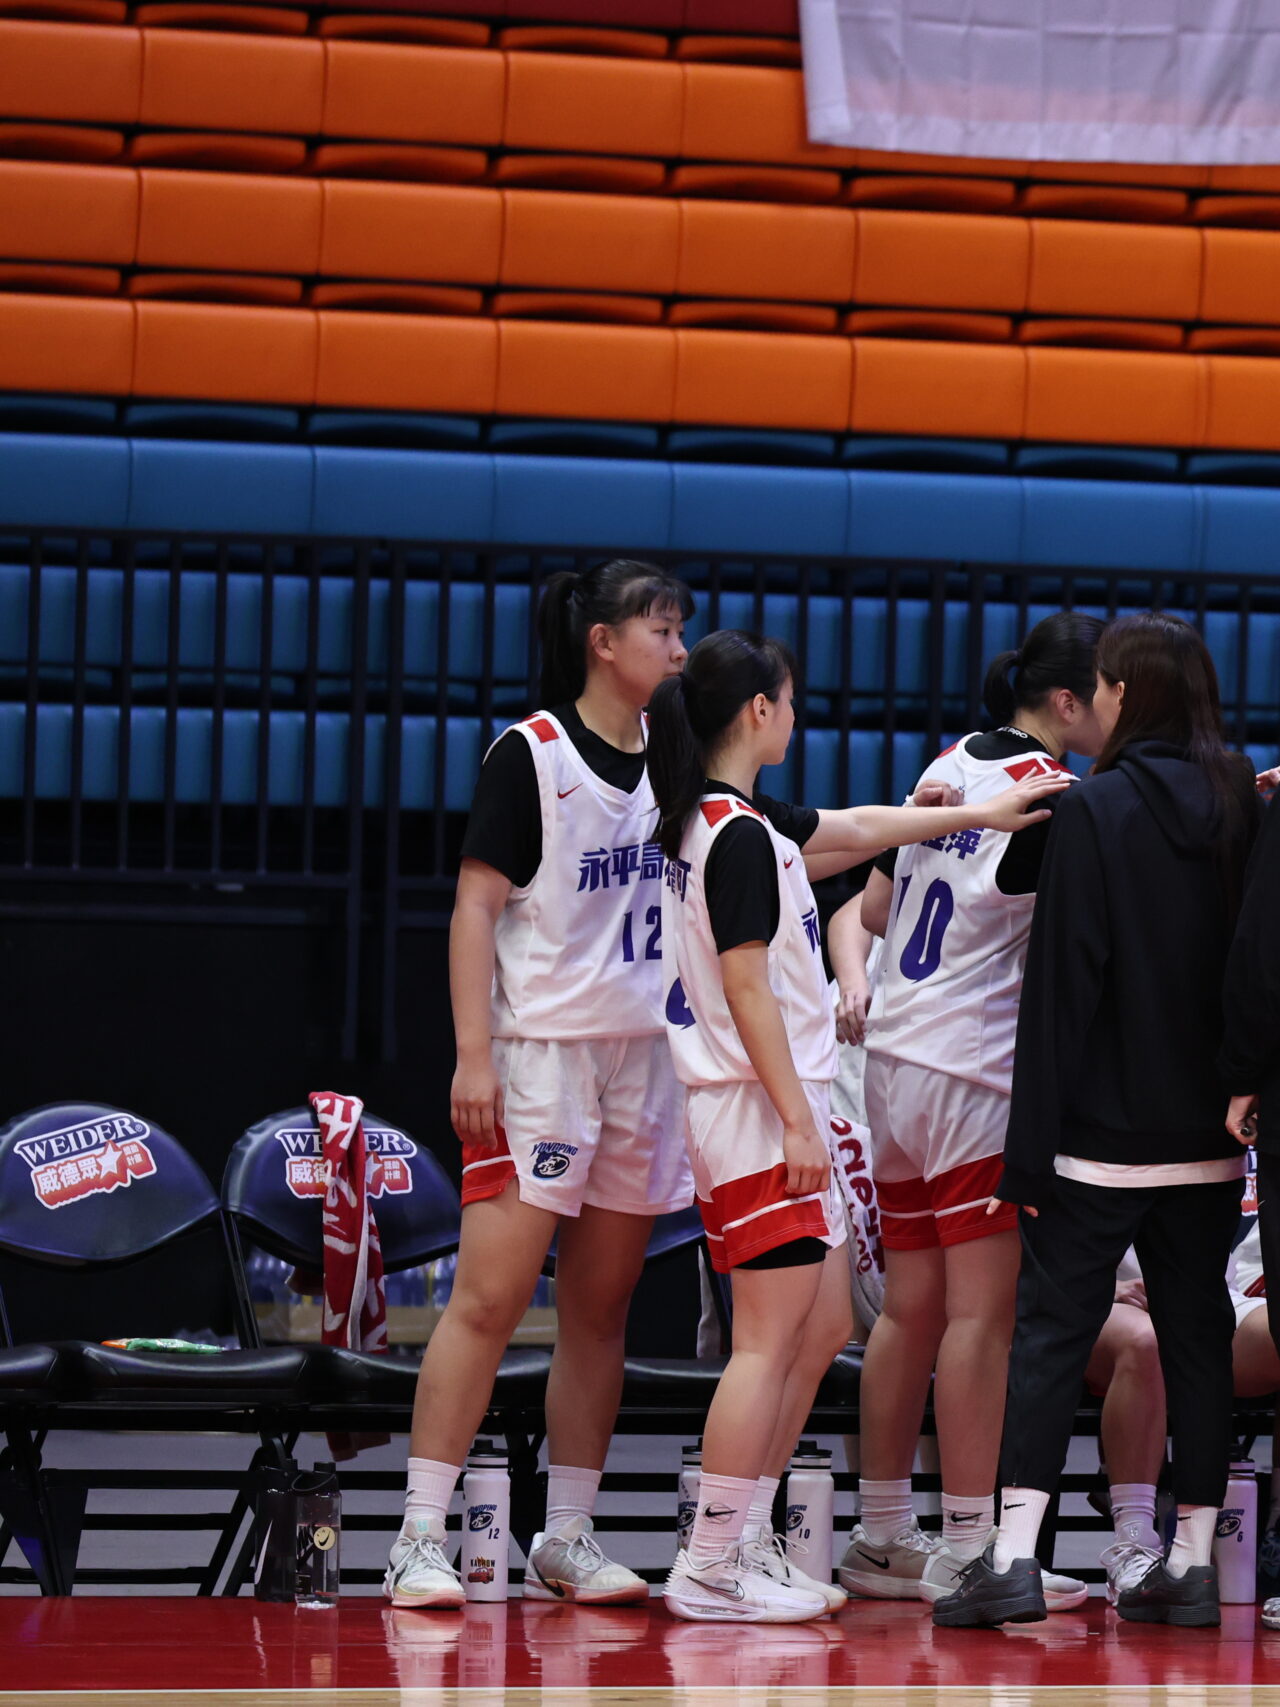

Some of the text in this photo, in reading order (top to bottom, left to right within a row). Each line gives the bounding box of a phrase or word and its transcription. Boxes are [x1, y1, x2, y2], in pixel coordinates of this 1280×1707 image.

[622, 904, 662, 962] 12
[22, 1117, 135, 1163] WEIDER
[488, 1528, 500, 1539] 12
[799, 1528, 811, 1539] 10
